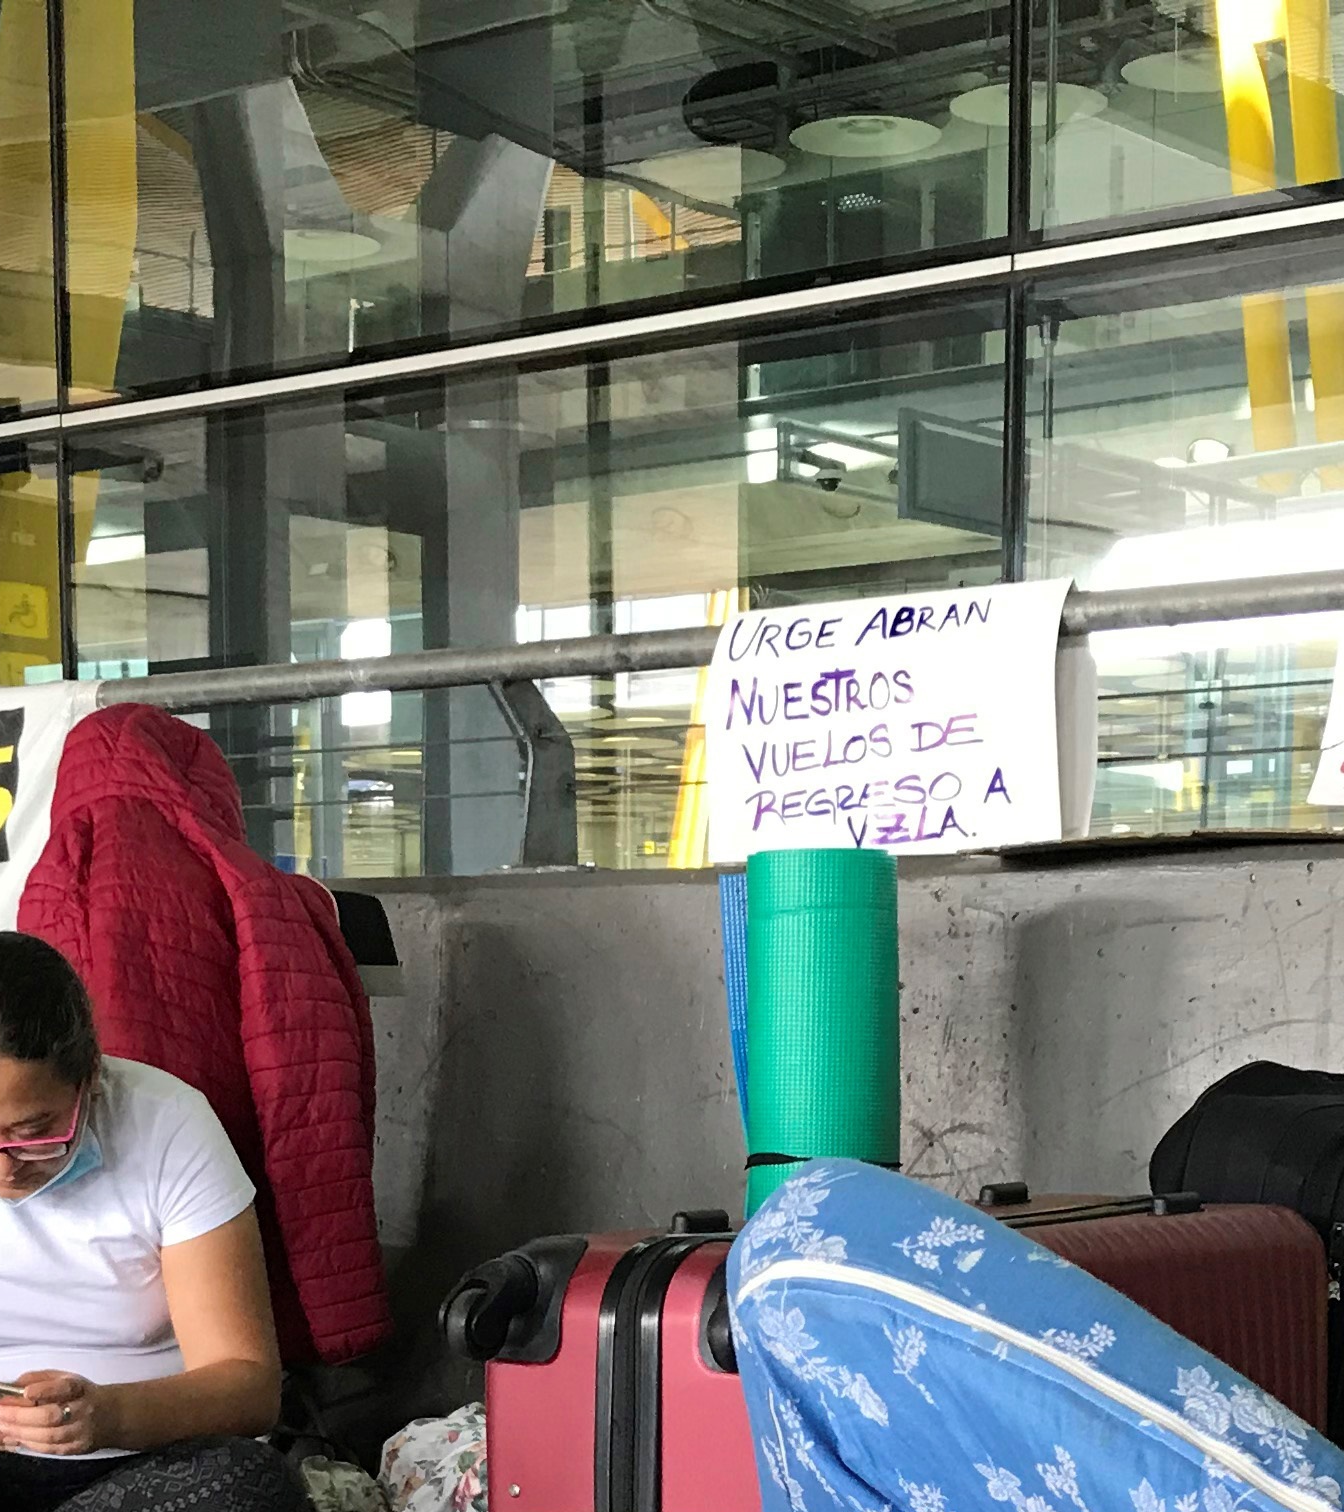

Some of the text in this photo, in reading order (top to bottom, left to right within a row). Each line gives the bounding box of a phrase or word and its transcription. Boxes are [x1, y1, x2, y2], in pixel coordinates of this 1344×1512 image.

[728, 598, 992, 662] URGE ABRAN
[726, 668, 915, 730] NUESTROS
[741, 713, 984, 784] VUELOS DE
[745, 766, 1012, 831] REGRESO A
